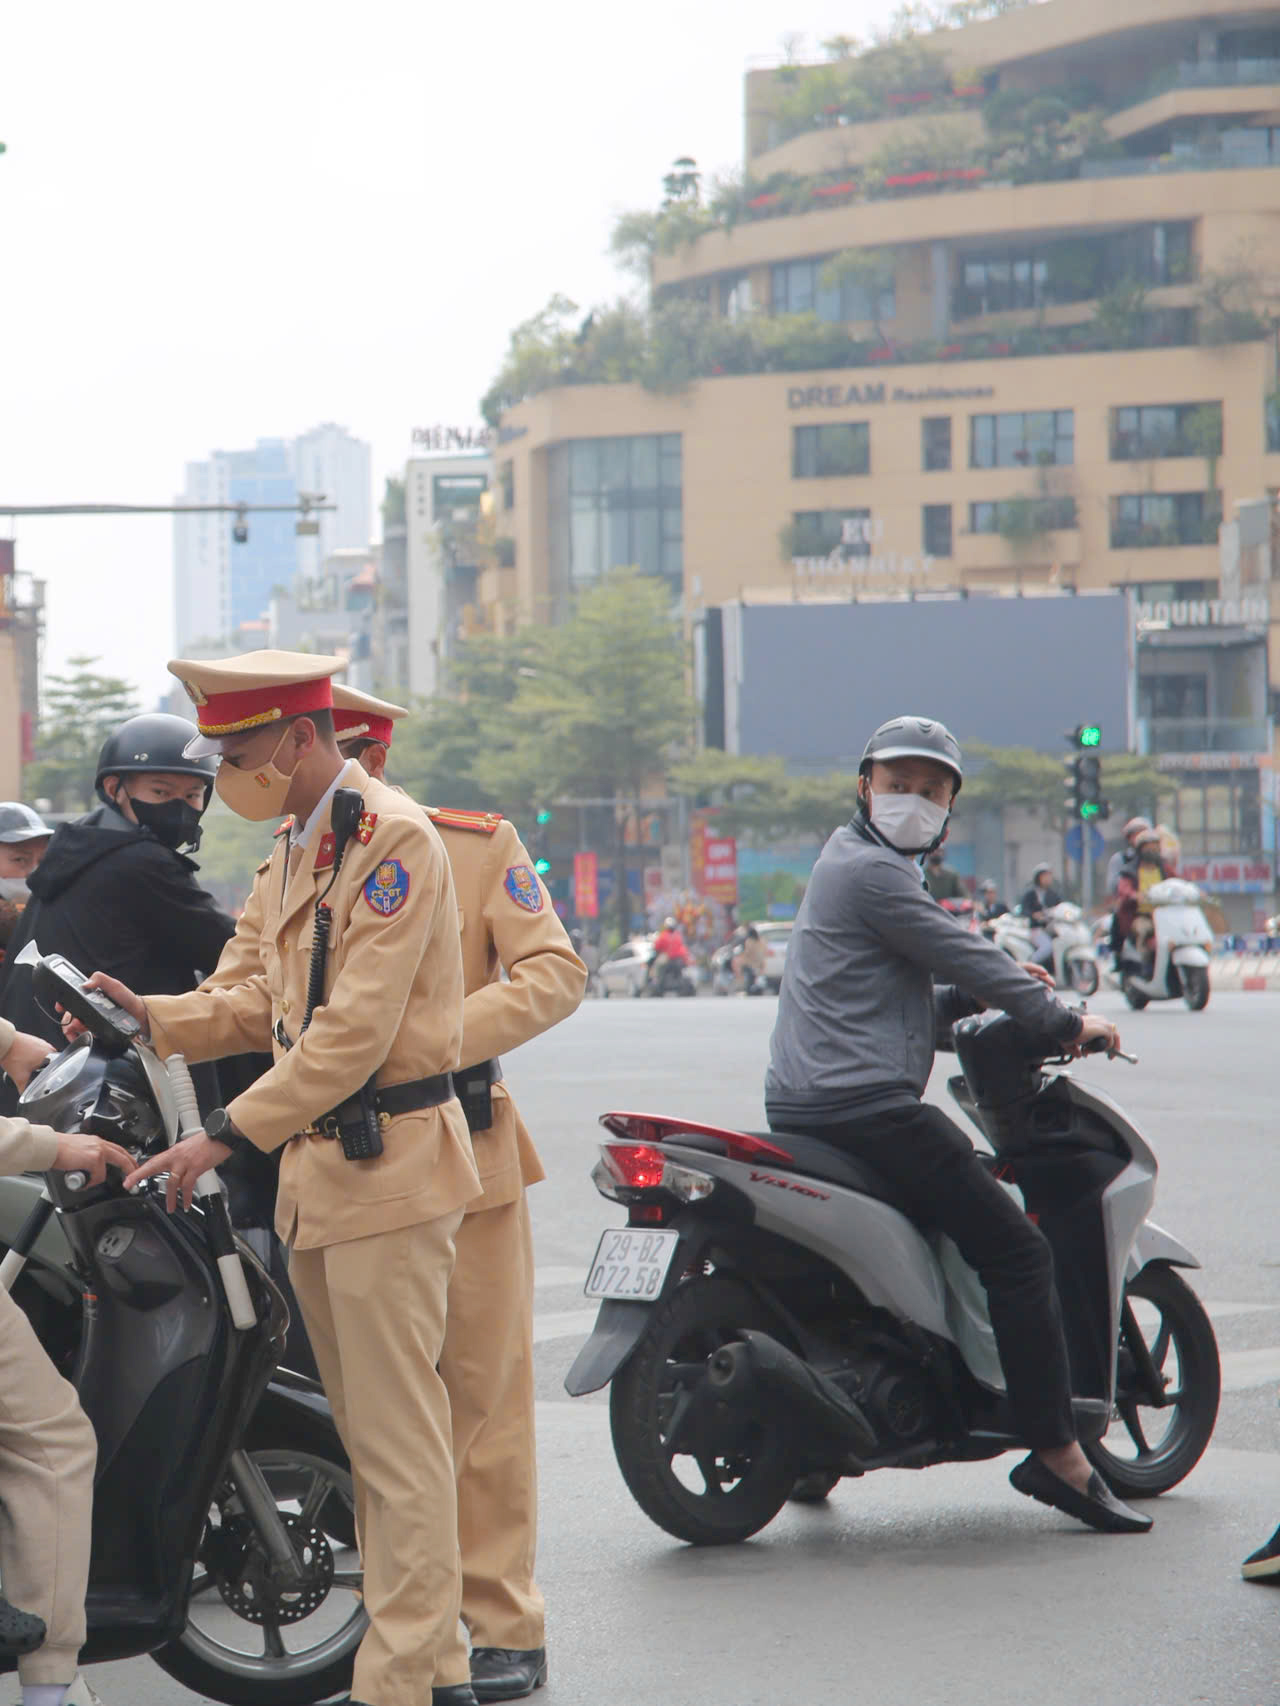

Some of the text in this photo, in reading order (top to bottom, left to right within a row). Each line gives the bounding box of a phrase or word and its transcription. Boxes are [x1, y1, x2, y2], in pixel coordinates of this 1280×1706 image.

[786, 384, 886, 409] DREAM
[605, 1233, 665, 1264] 29-B2
[590, 1265, 662, 1295] 072.58
